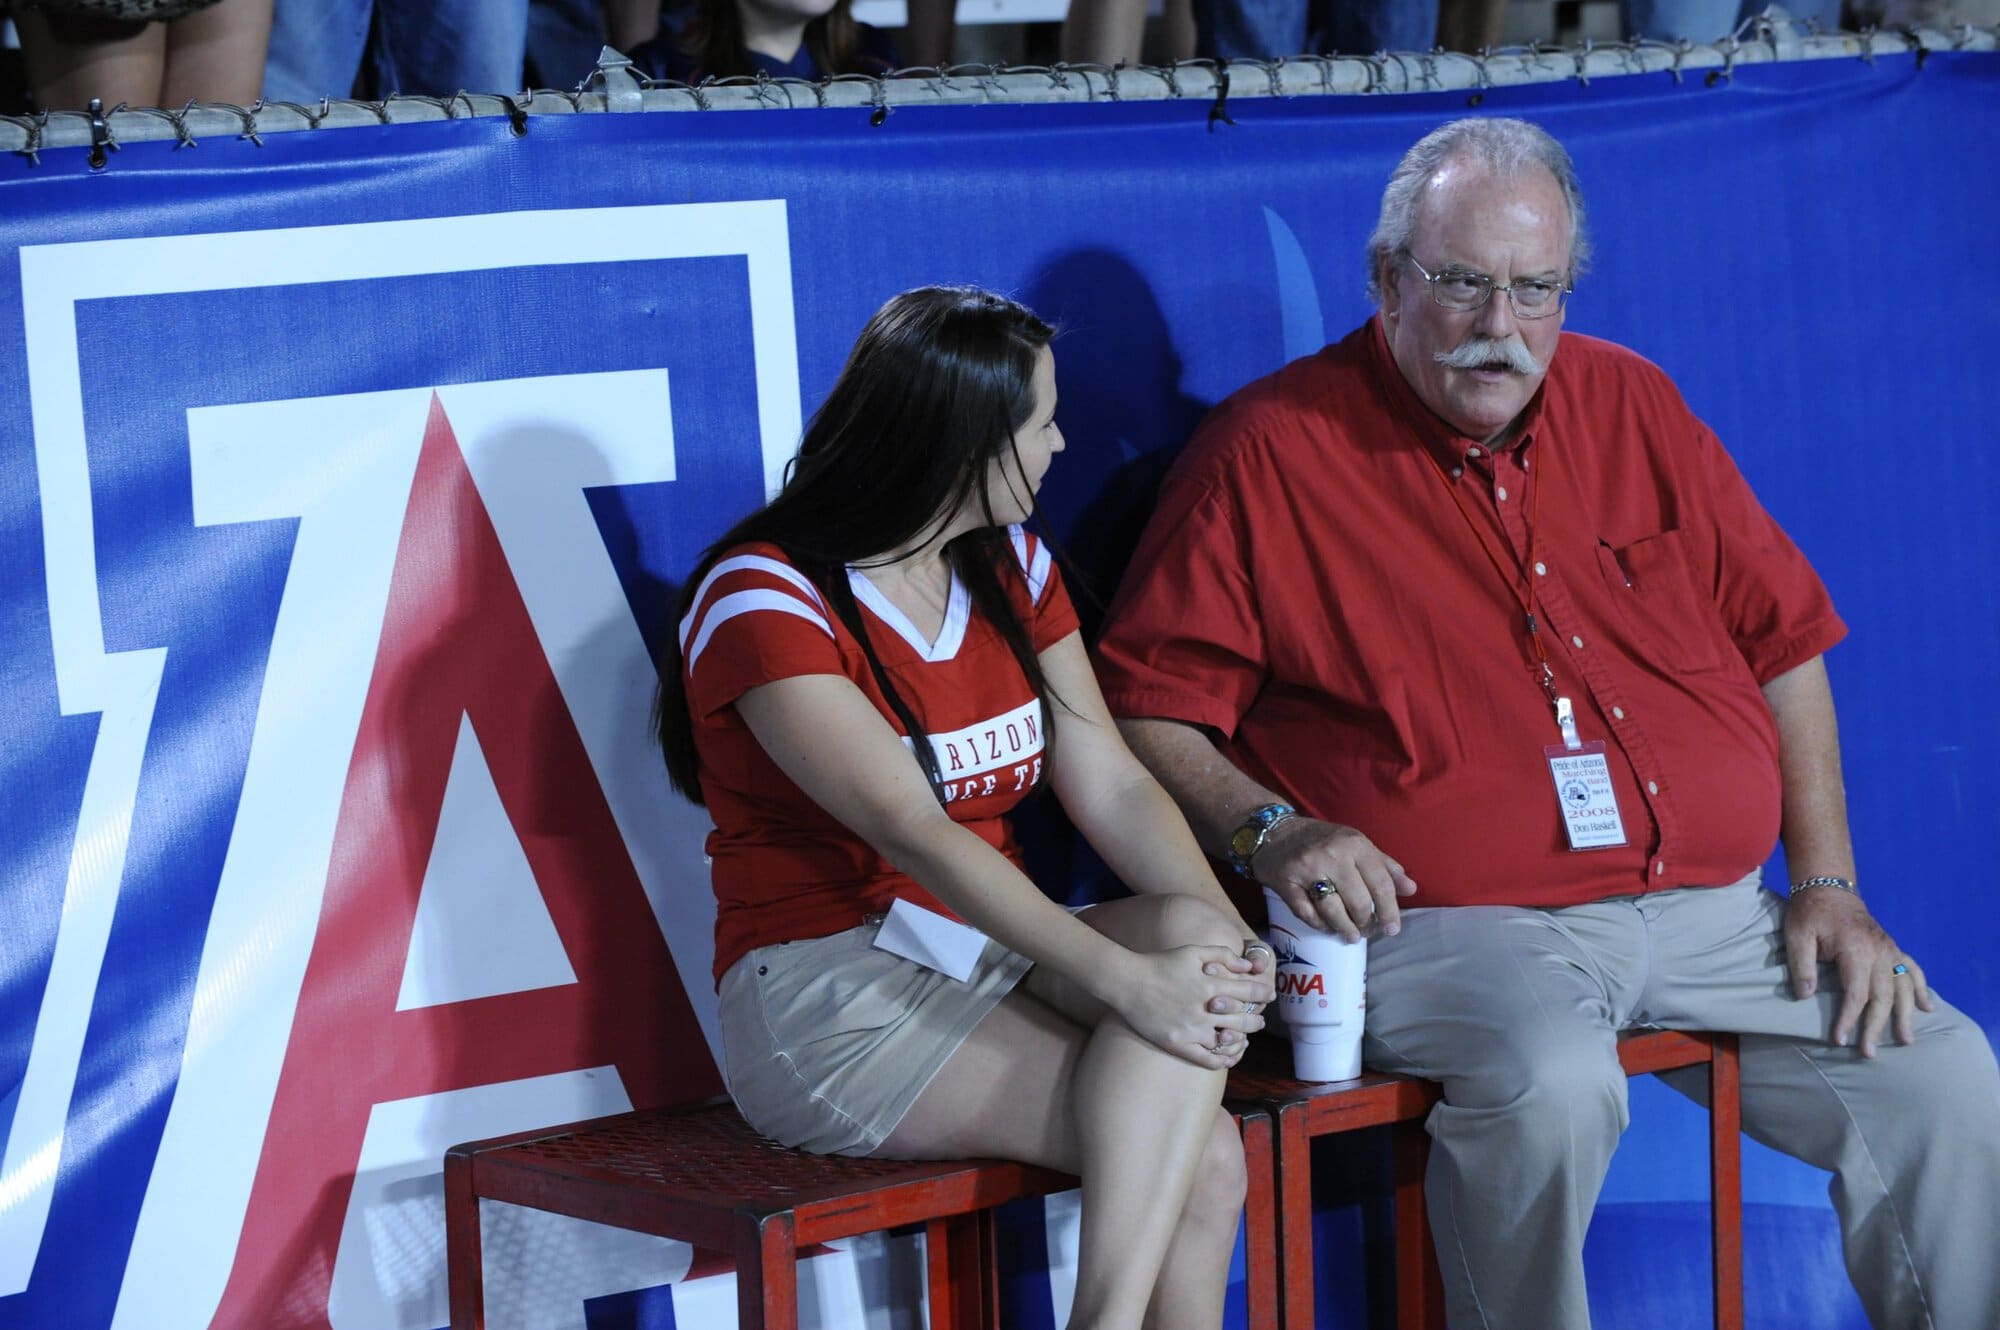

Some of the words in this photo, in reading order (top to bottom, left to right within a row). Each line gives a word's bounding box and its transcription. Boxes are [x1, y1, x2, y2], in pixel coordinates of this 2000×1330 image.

[945, 714, 1038, 771] RIZON
[1580, 758, 1604, 769] Arizona
[1562, 768, 1606, 777] Marching
[944, 774, 997, 803] NCE
[1014, 757, 1041, 791] TE
[1568, 807, 1616, 819] 2008
[1573, 823, 1589, 833] Don
[1590, 820, 1616, 832] Haskell
[1276, 972, 1324, 996] ONA
